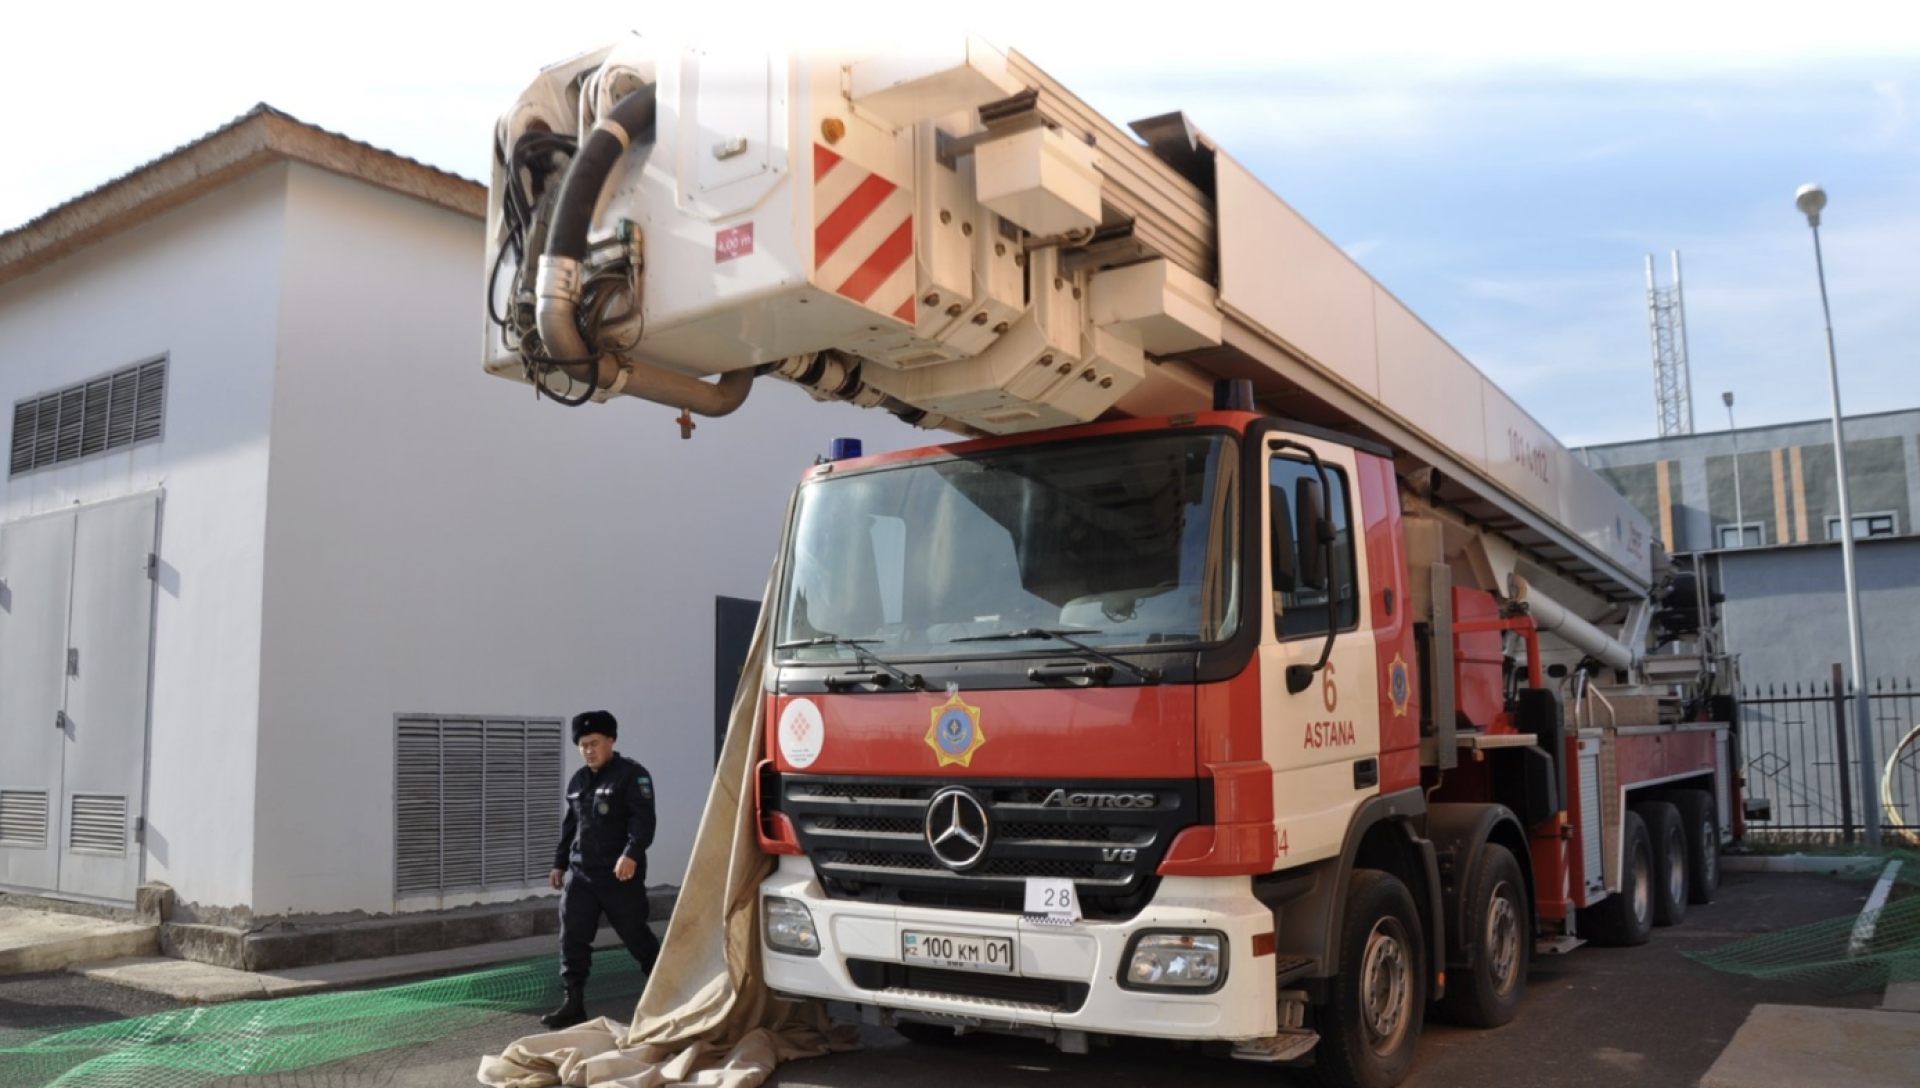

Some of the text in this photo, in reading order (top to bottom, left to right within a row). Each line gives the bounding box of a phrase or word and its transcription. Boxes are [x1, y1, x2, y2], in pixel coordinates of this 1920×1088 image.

[1322, 661, 1337, 714] 6
[1304, 720, 1356, 749] ASTANA
[1044, 888, 1071, 908] 28
[922, 936, 952, 959] 100
[958, 943, 979, 961] KM
[986, 942, 1009, 964] 01
